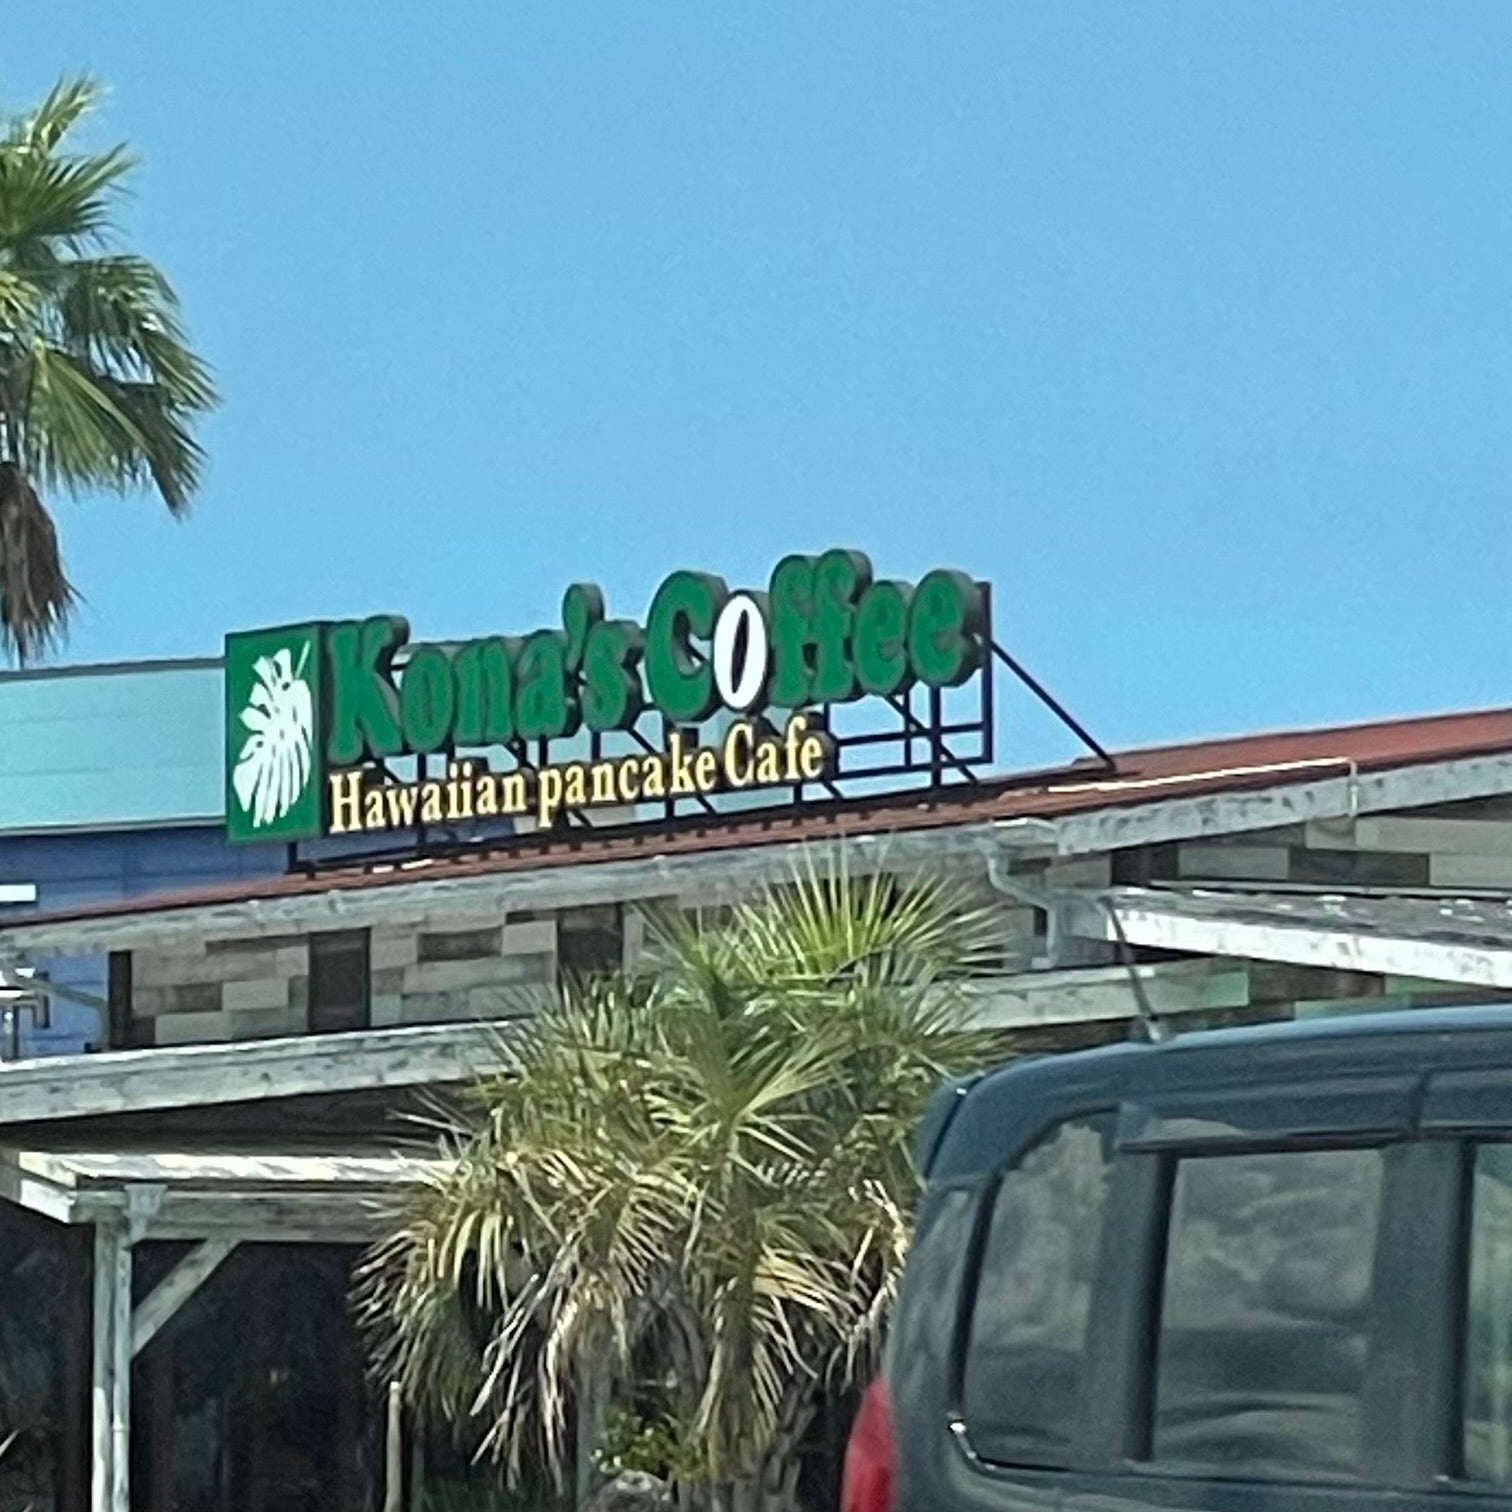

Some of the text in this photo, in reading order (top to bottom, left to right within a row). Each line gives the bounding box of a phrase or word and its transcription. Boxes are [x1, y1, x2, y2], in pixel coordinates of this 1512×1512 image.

[328, 549, 976, 765] Kona's Coffee
[330, 715, 823, 834] Hawaiian pancake Cafe
